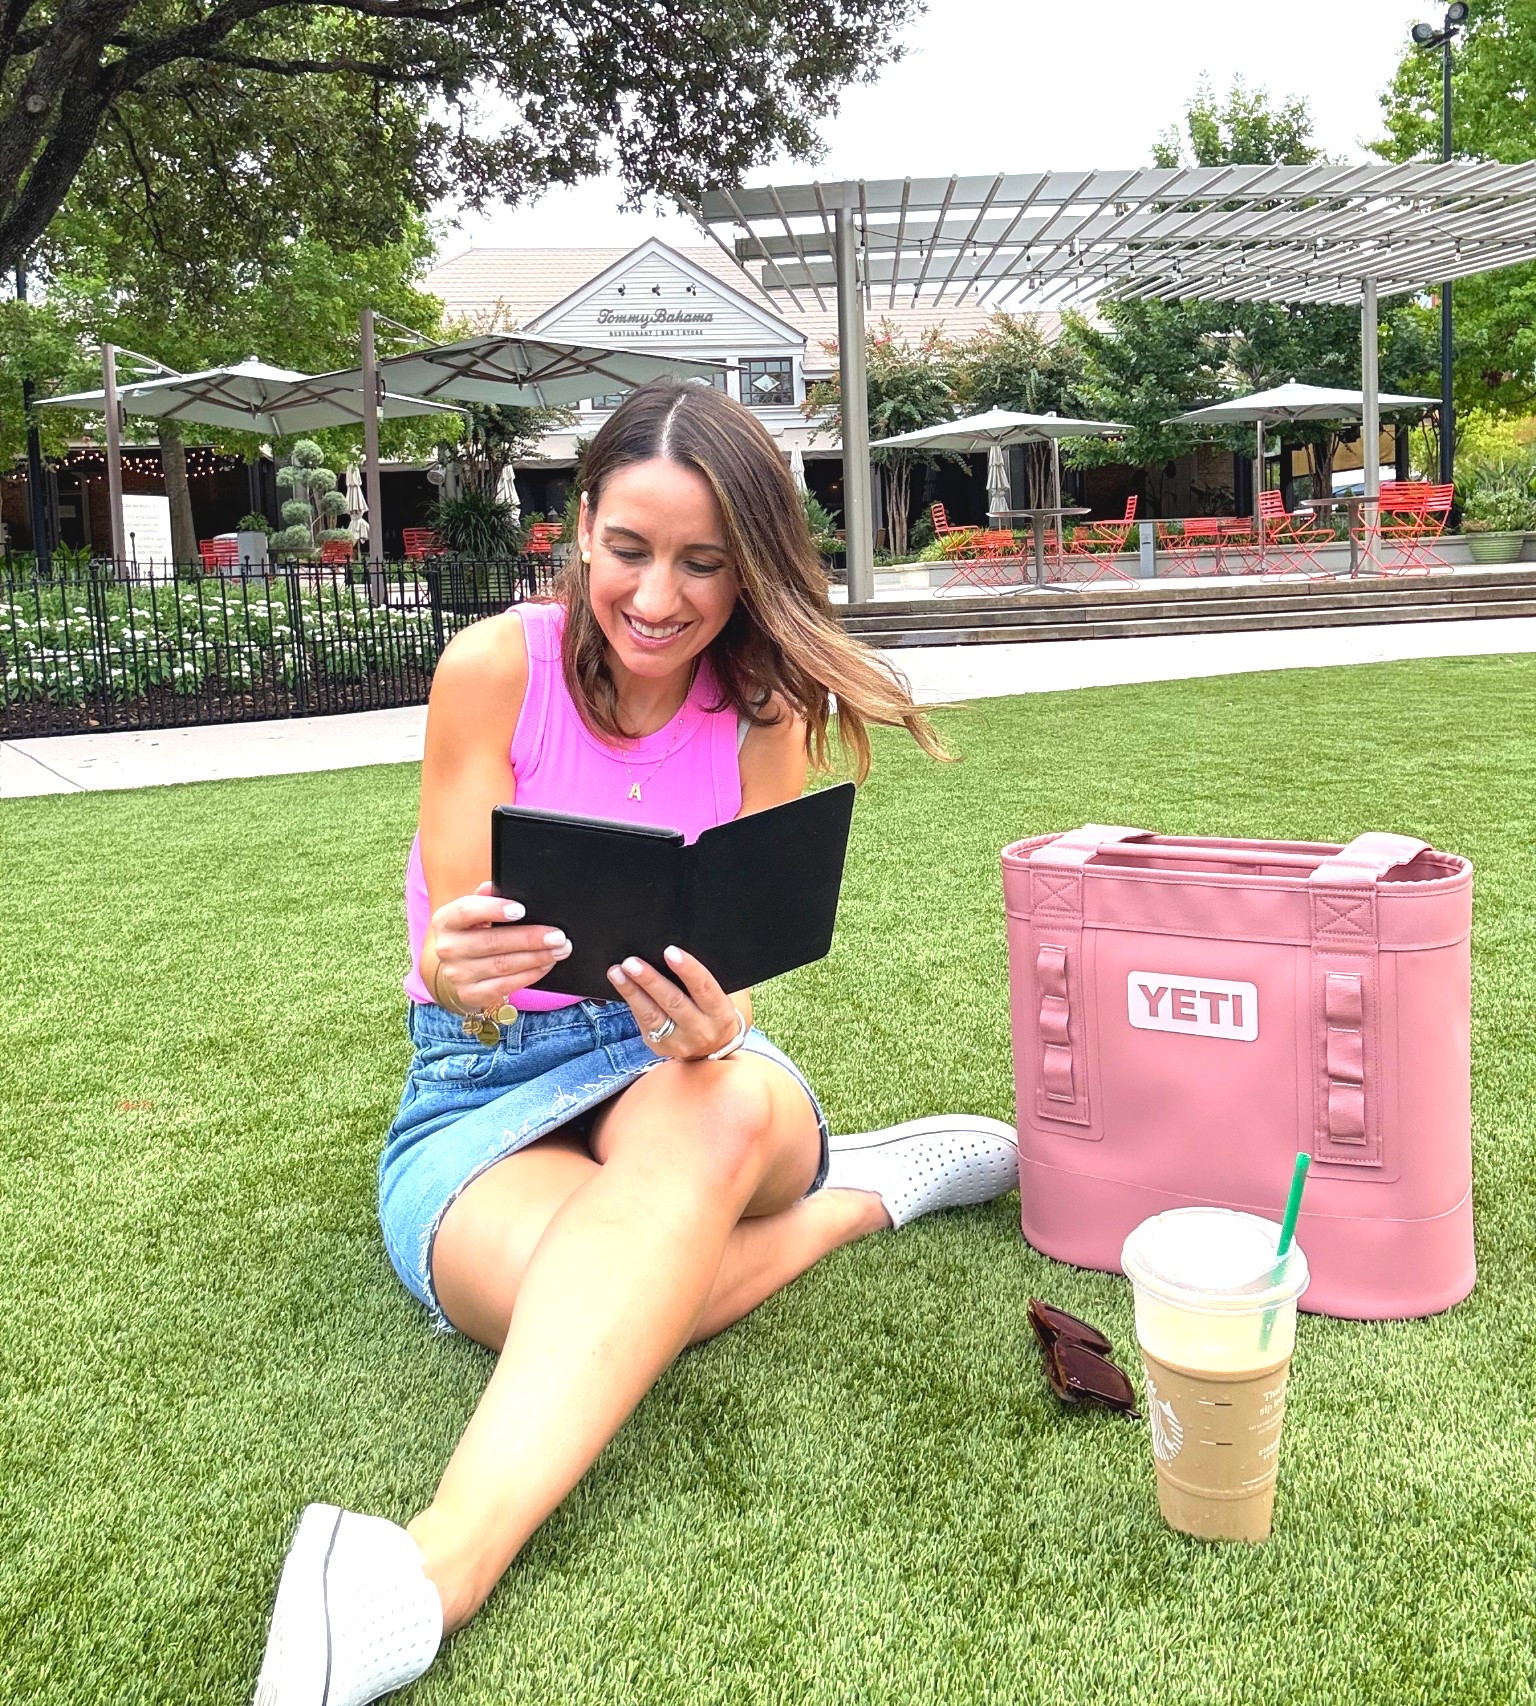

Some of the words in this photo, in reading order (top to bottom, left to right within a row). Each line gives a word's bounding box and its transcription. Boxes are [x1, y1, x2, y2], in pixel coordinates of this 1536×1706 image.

[597, 308, 651, 329] Tommy
[651, 308, 714, 324] Bahama
[627, 782, 642, 803] A
[1138, 983, 1244, 1028] YETI
